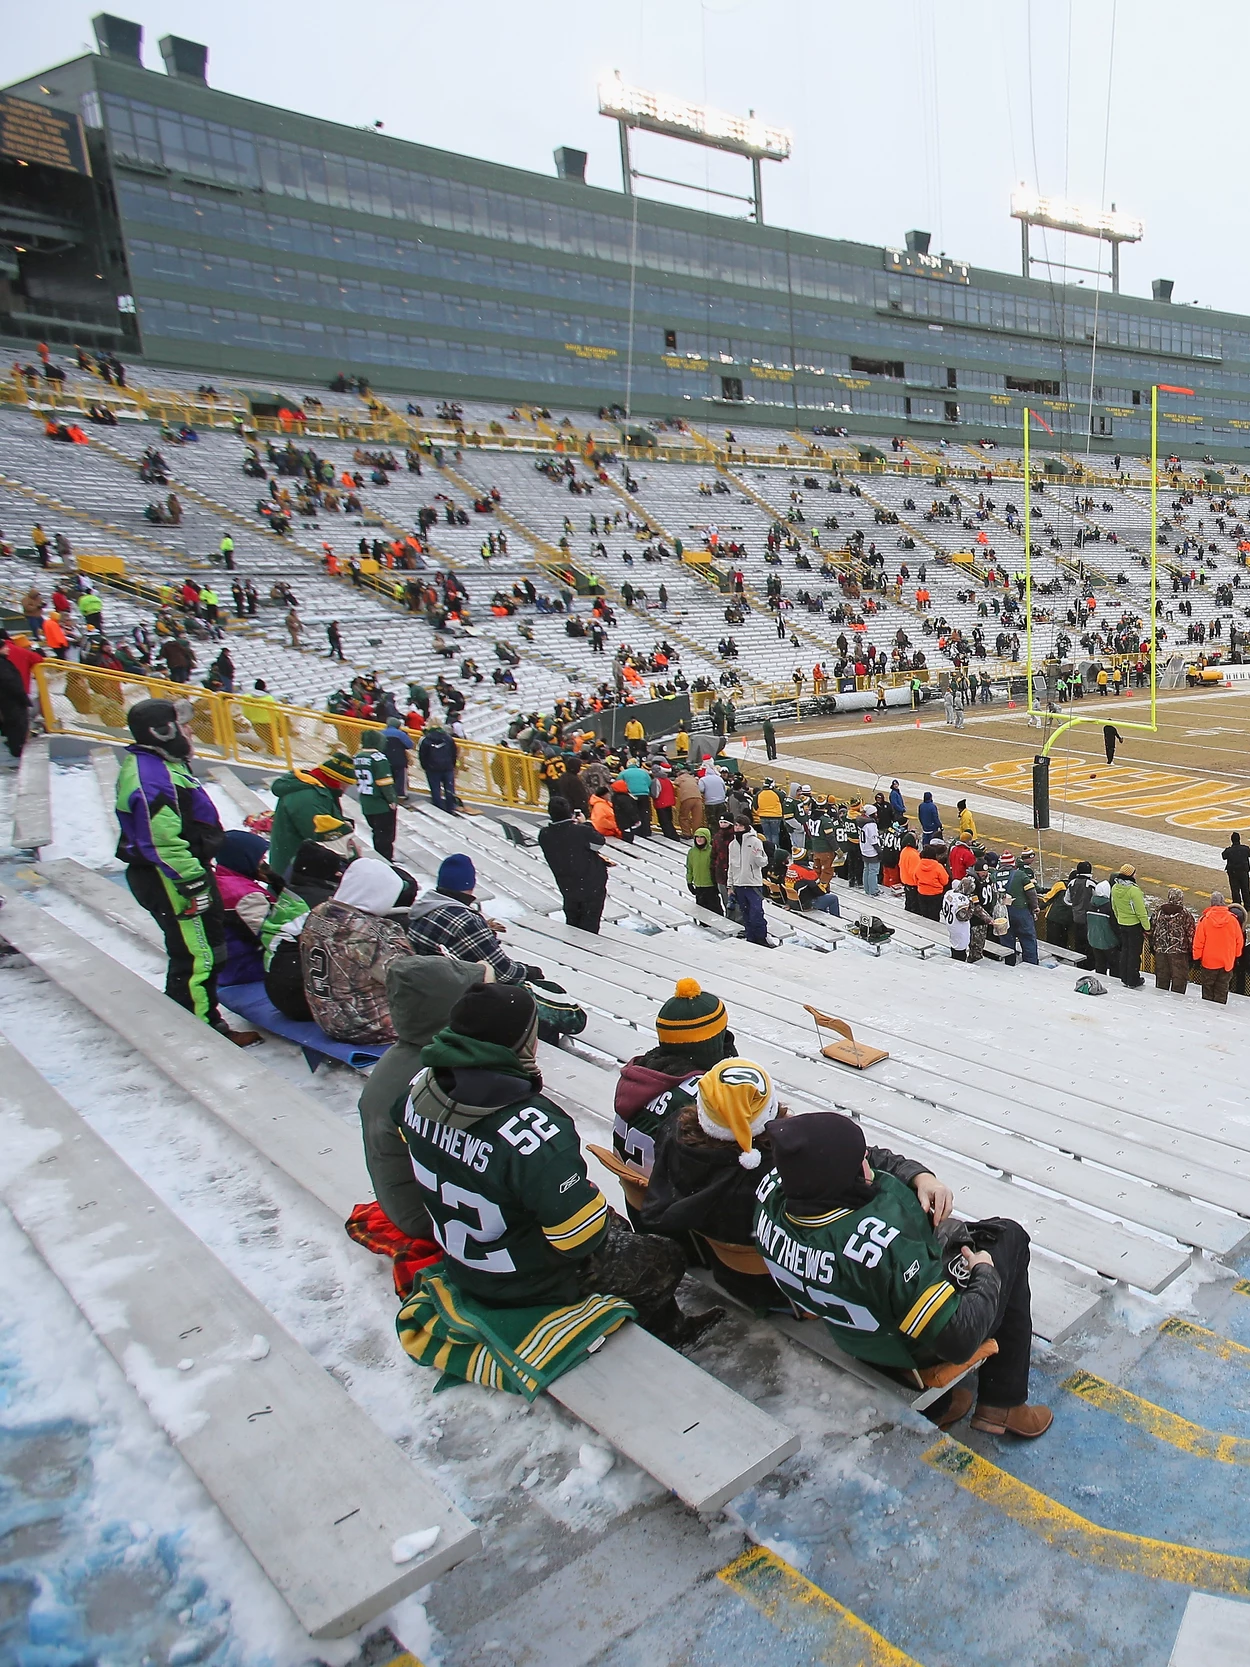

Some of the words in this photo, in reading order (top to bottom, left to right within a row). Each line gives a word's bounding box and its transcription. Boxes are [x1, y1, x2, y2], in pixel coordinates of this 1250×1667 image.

[808, 819, 821, 837] 87
[982, 884, 993, 906] 99
[497, 1105, 561, 1156] 52
[755, 1209, 836, 1285] MATTHEWS
[842, 1216, 901, 1269] 52
[179, 1327, 202, 1339] 3
[247, 1406, 273, 1422] 2
[334, 1509, 360, 1525] 1
